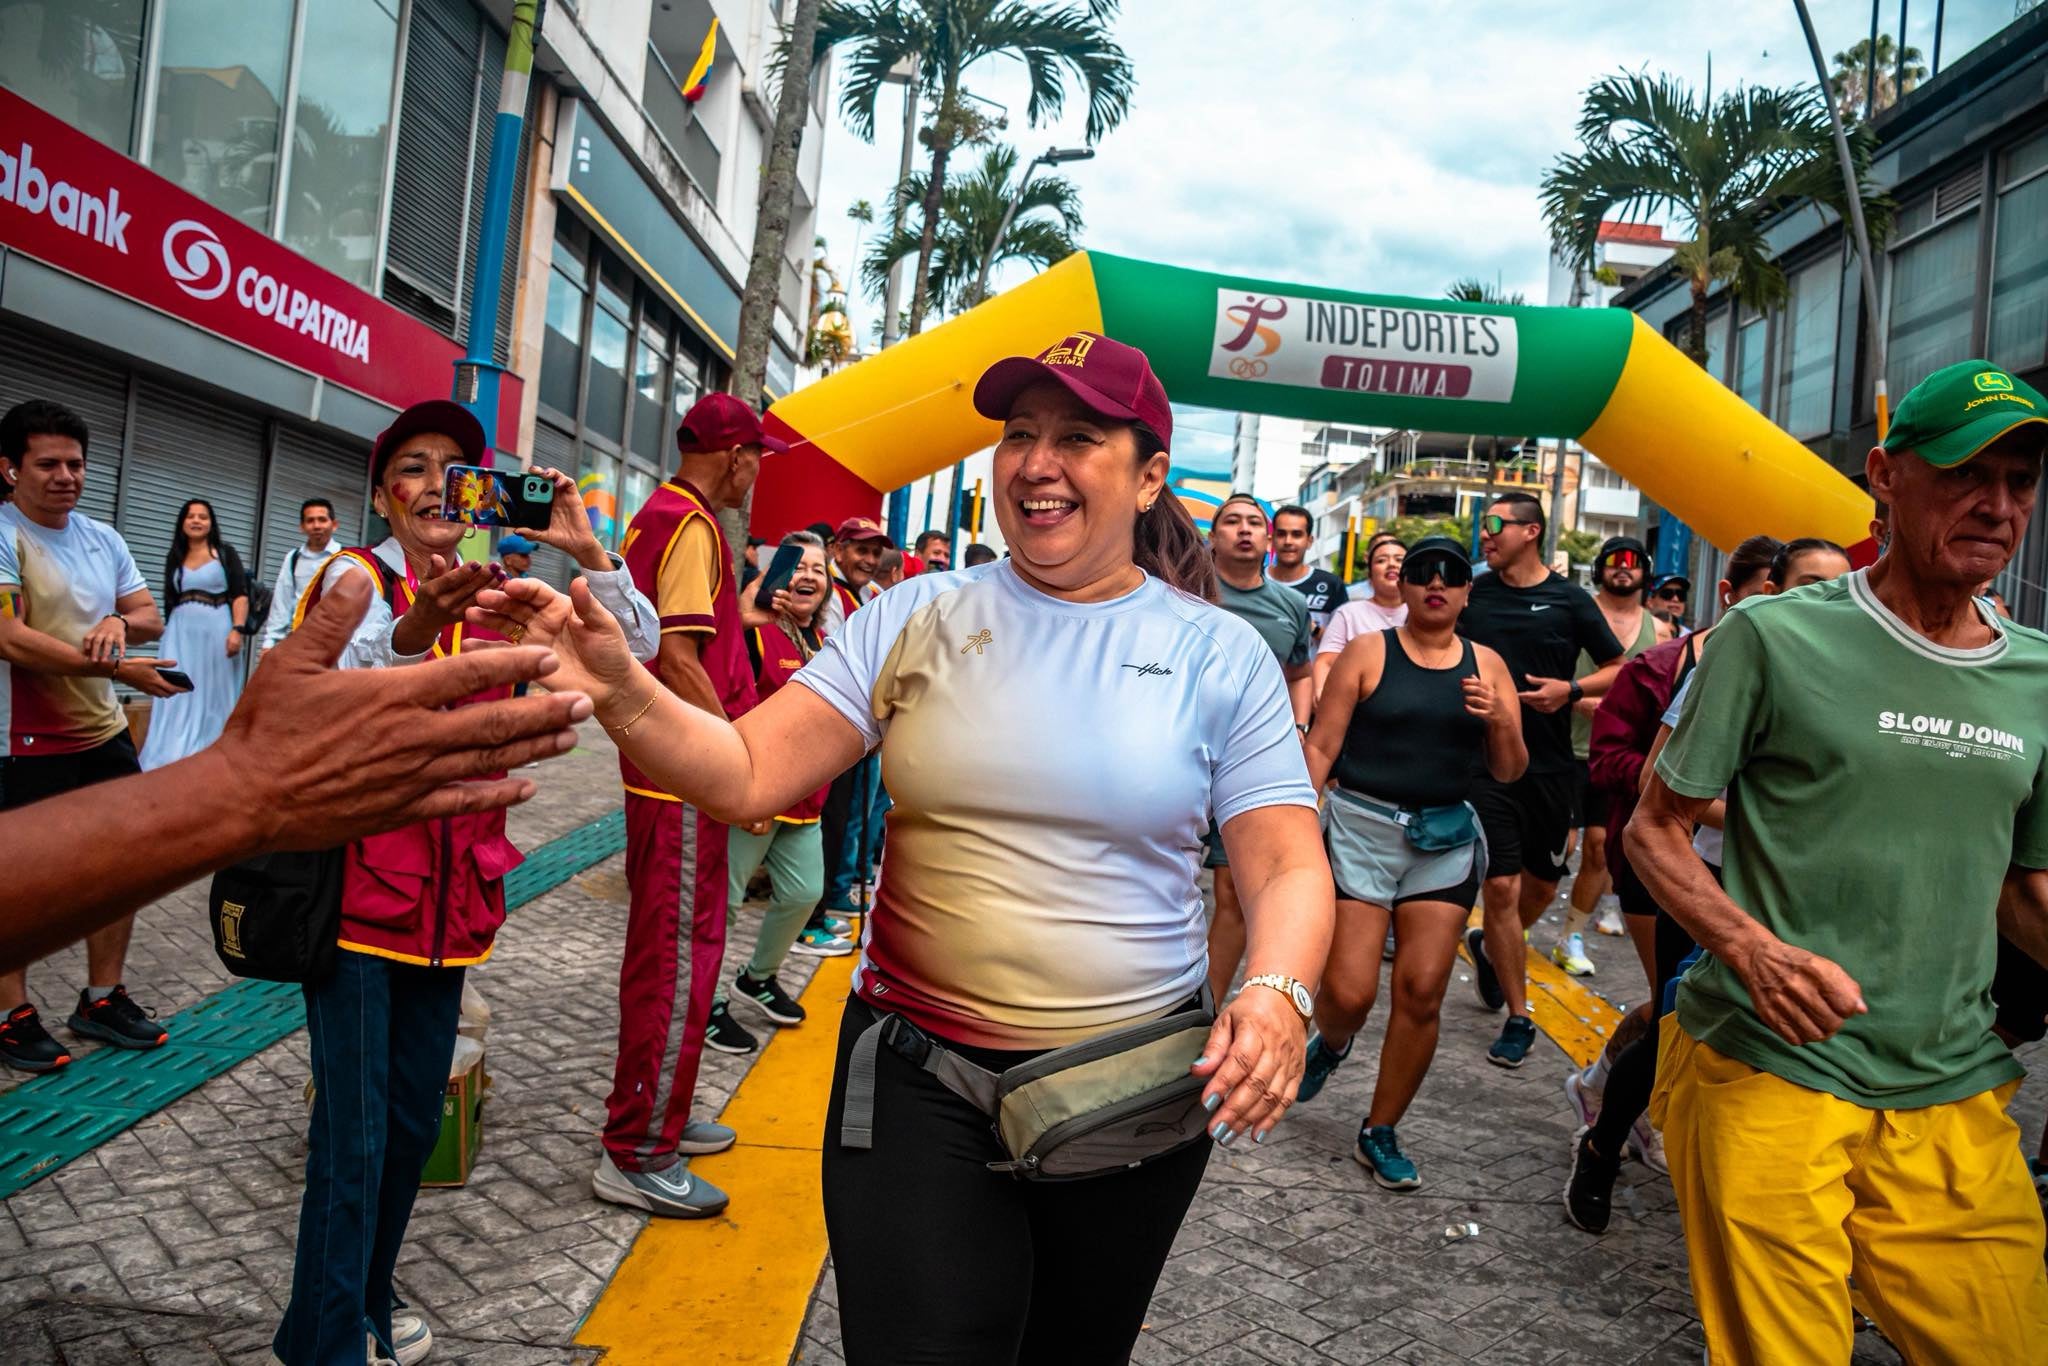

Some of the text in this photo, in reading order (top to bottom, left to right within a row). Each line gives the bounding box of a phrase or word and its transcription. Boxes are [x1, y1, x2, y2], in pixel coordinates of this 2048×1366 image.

[236, 266, 370, 364] COLPATRIA
[1306, 301, 1500, 358] INDEPORTES
[1342, 361, 1447, 396] TOLIMA
[1964, 393, 2035, 411] JOHN DEERE
[1878, 711, 2024, 753] SLOW DOWN
